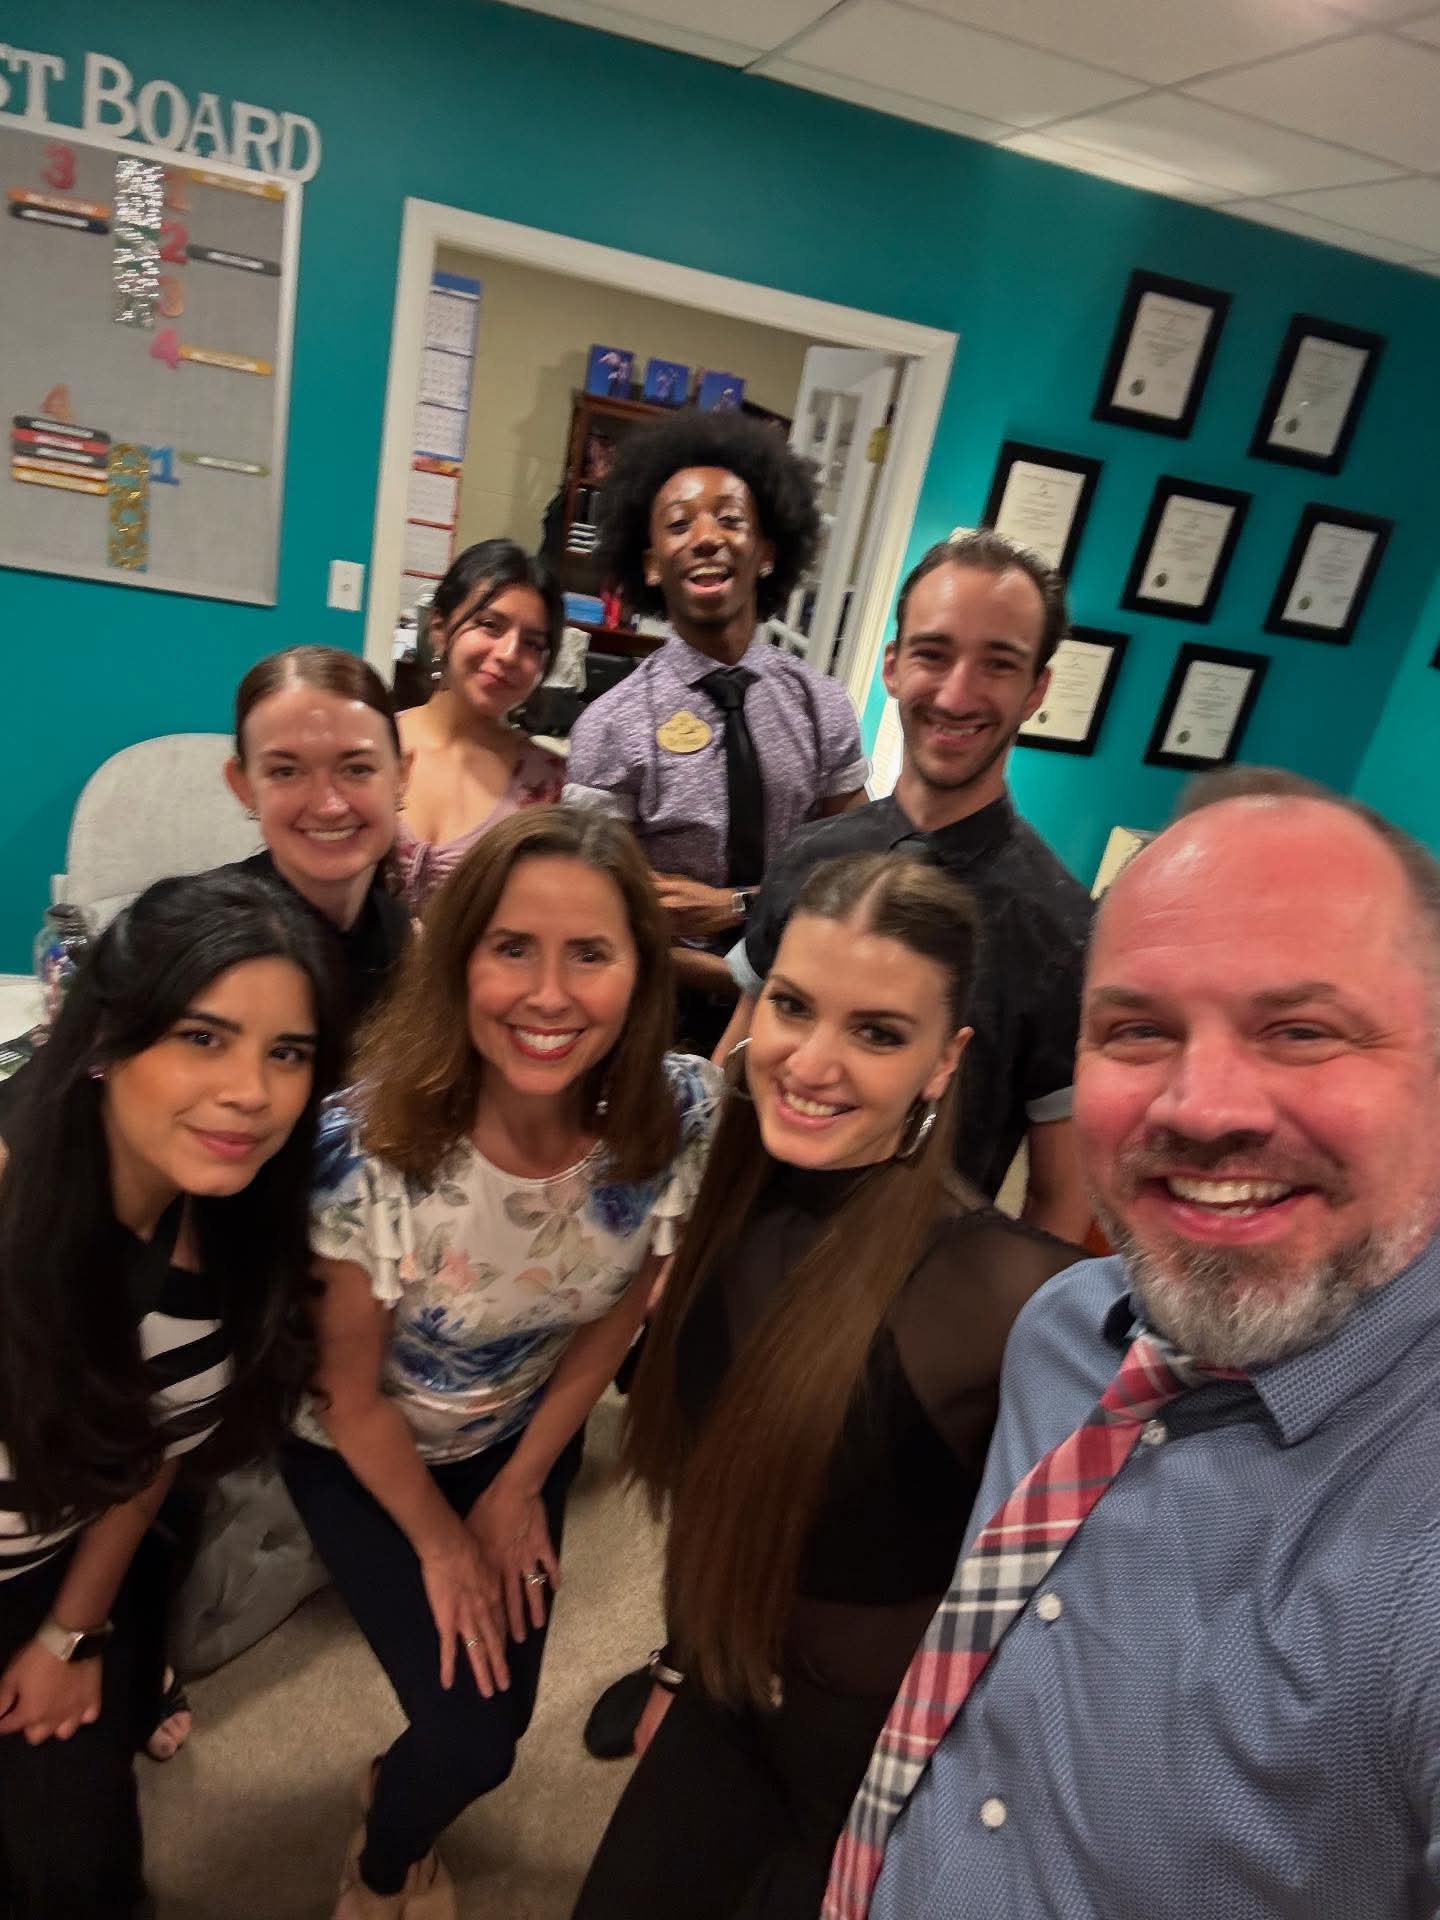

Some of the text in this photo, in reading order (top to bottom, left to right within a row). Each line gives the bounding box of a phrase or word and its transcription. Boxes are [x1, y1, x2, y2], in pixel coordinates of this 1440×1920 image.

[0, 43, 322, 183] T BOARD
[43, 145, 77, 190] 3
[159, 219, 190, 265] 2
[147, 445, 181, 487] 1
